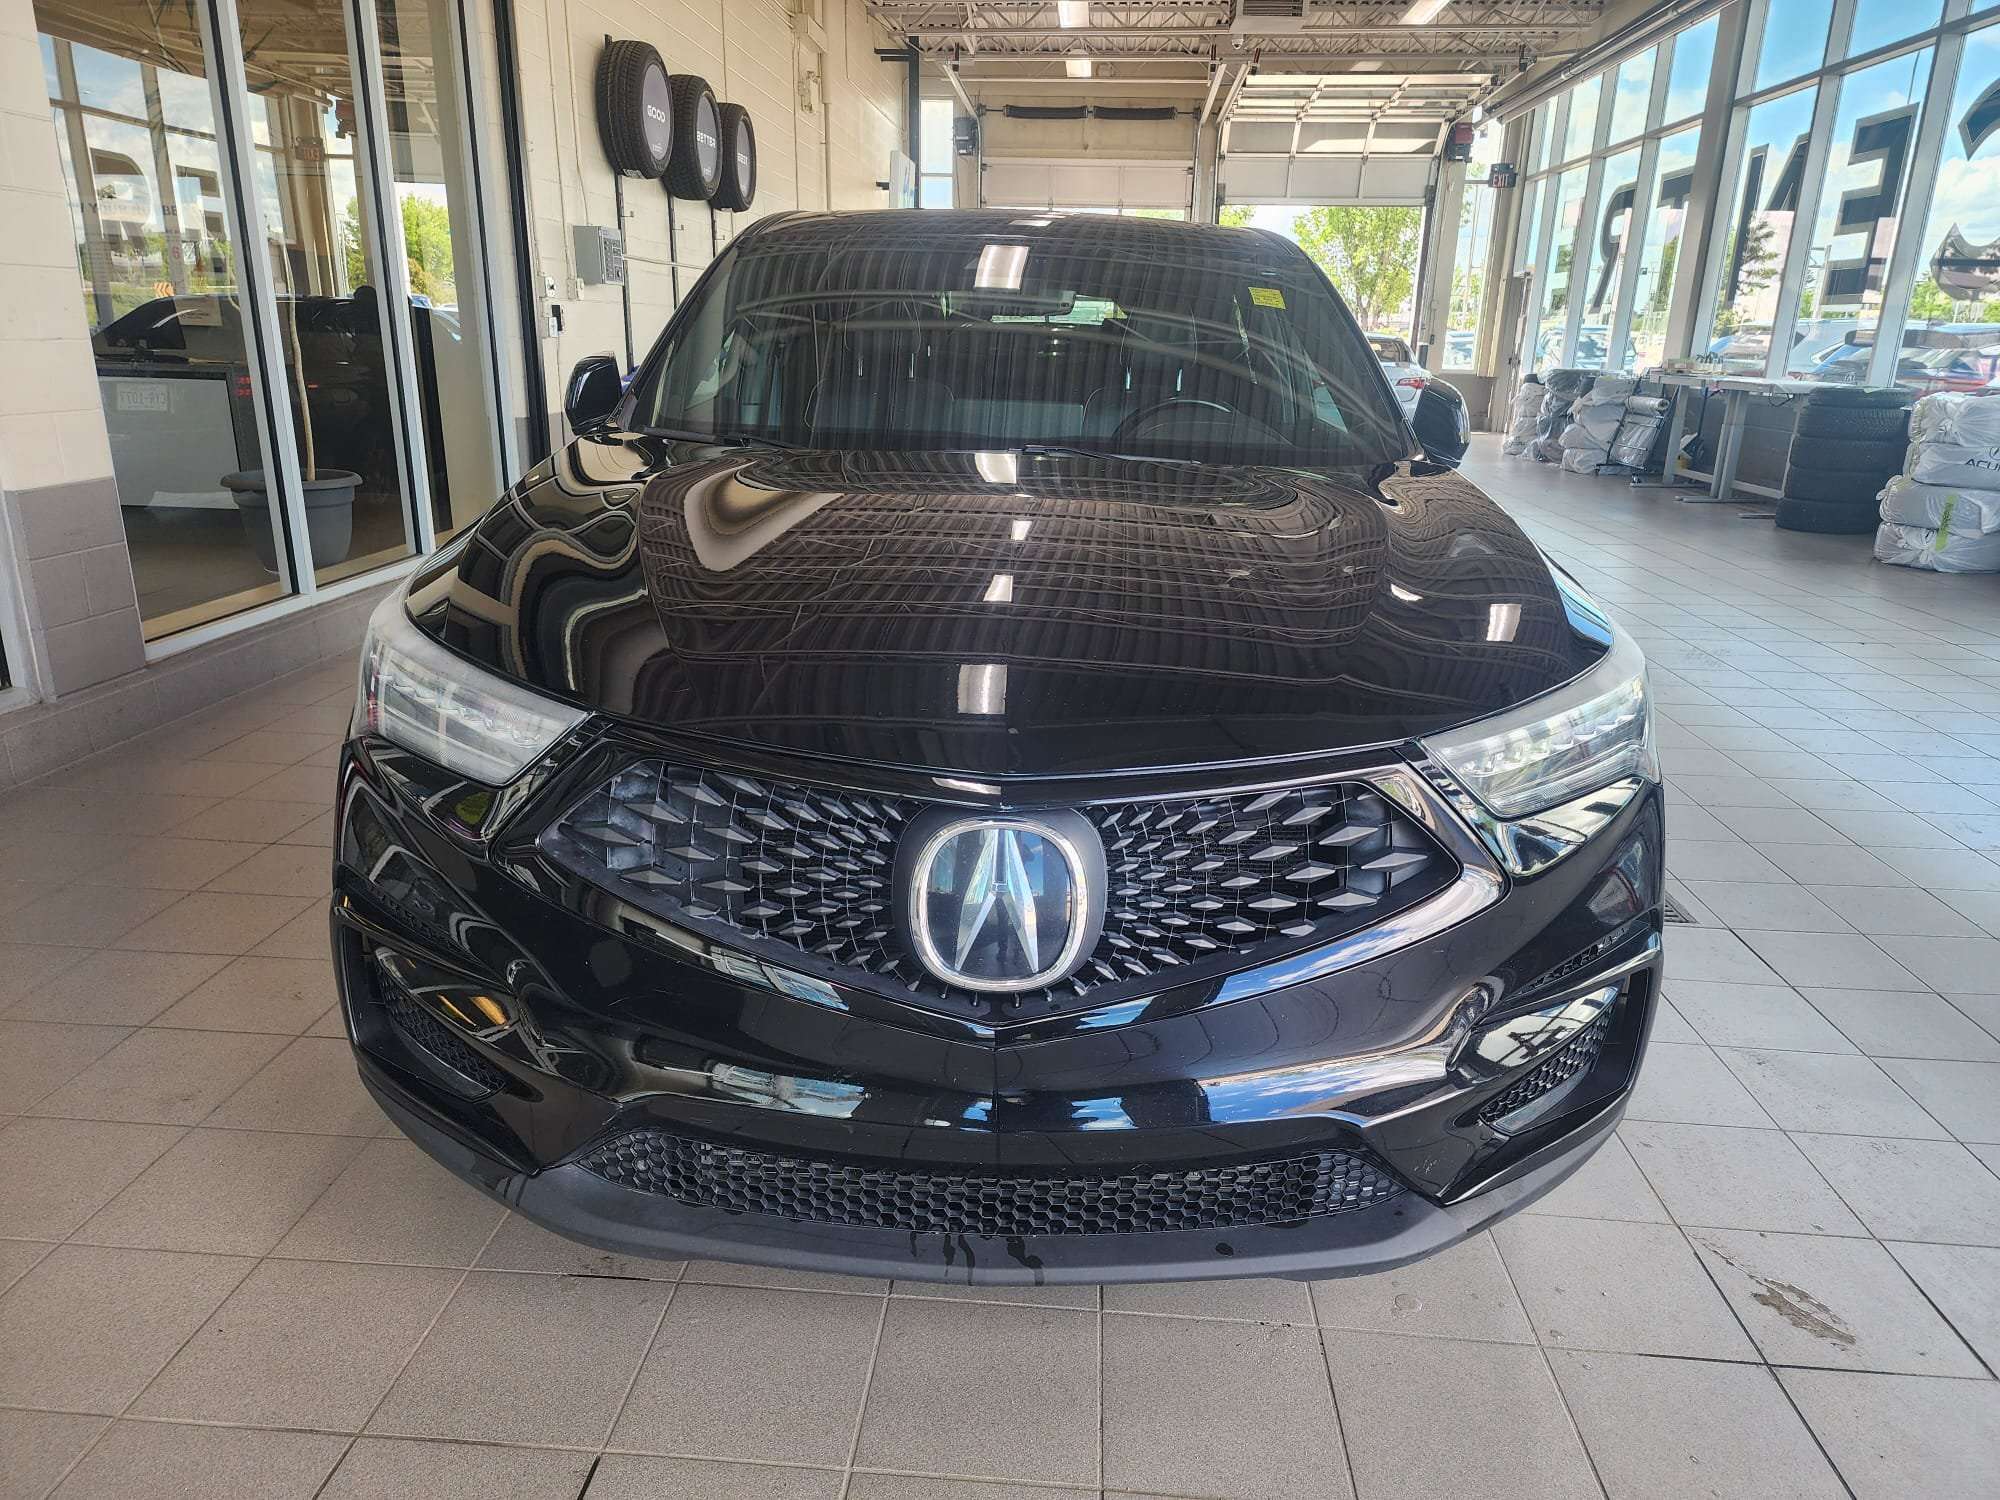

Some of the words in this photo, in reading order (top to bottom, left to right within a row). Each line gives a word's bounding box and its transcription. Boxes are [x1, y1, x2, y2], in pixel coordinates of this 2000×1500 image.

[647, 104, 666, 123] GOOD
[696, 131, 717, 149] BETTER
[1492, 173, 1508, 187] EXIT
